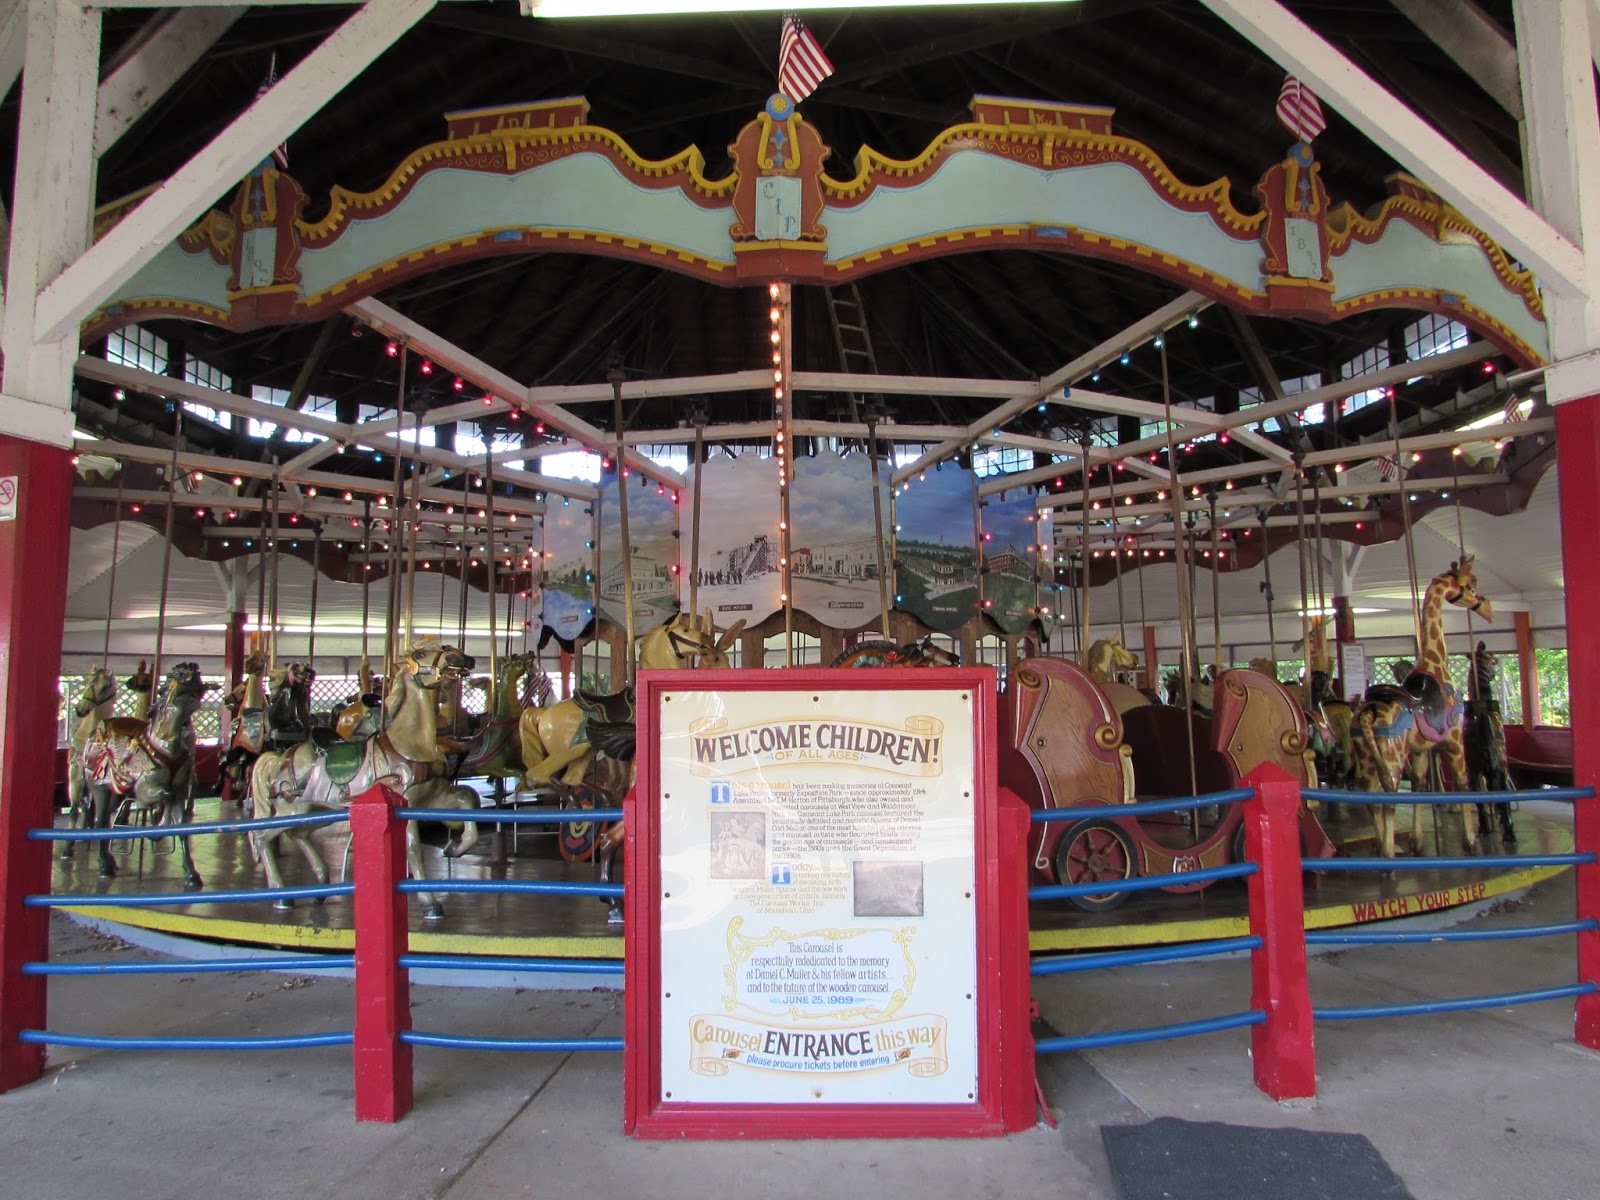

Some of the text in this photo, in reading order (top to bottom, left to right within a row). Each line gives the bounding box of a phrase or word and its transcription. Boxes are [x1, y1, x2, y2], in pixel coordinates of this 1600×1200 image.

[694, 724, 940, 765] WELCOME CHILDREN!
[775, 749, 860, 761] OF ALL AGES
[822, 782, 845, 791] making
[868, 789, 911, 799] approximately
[1351, 882, 1486, 922] WATCH YOUR STEP
[788, 942, 802, 953] This
[803, 942, 834, 953] Carousel
[751, 955, 793, 967] respectfully
[795, 956, 837, 966] rededicated
[847, 956, 858, 966] the
[859, 958, 890, 968] memory
[755, 969, 778, 980] Daniel
[787, 969, 810, 980] Muller
[820, 969, 831, 980] his
[833, 969, 856, 980] fellow
[747, 982, 762, 993] and
[771, 982, 783, 993] the
[784, 982, 806, 993] future
[816, 982, 828, 993] the
[829, 982, 857, 993] wooden
[858, 982, 891, 993] carousel.
[782, 996, 809, 1004] JUNE
[693, 1019, 942, 1060] Carousel ENTRANCE this way
[747, 1054, 890, 1070] please procure tickets before entering
